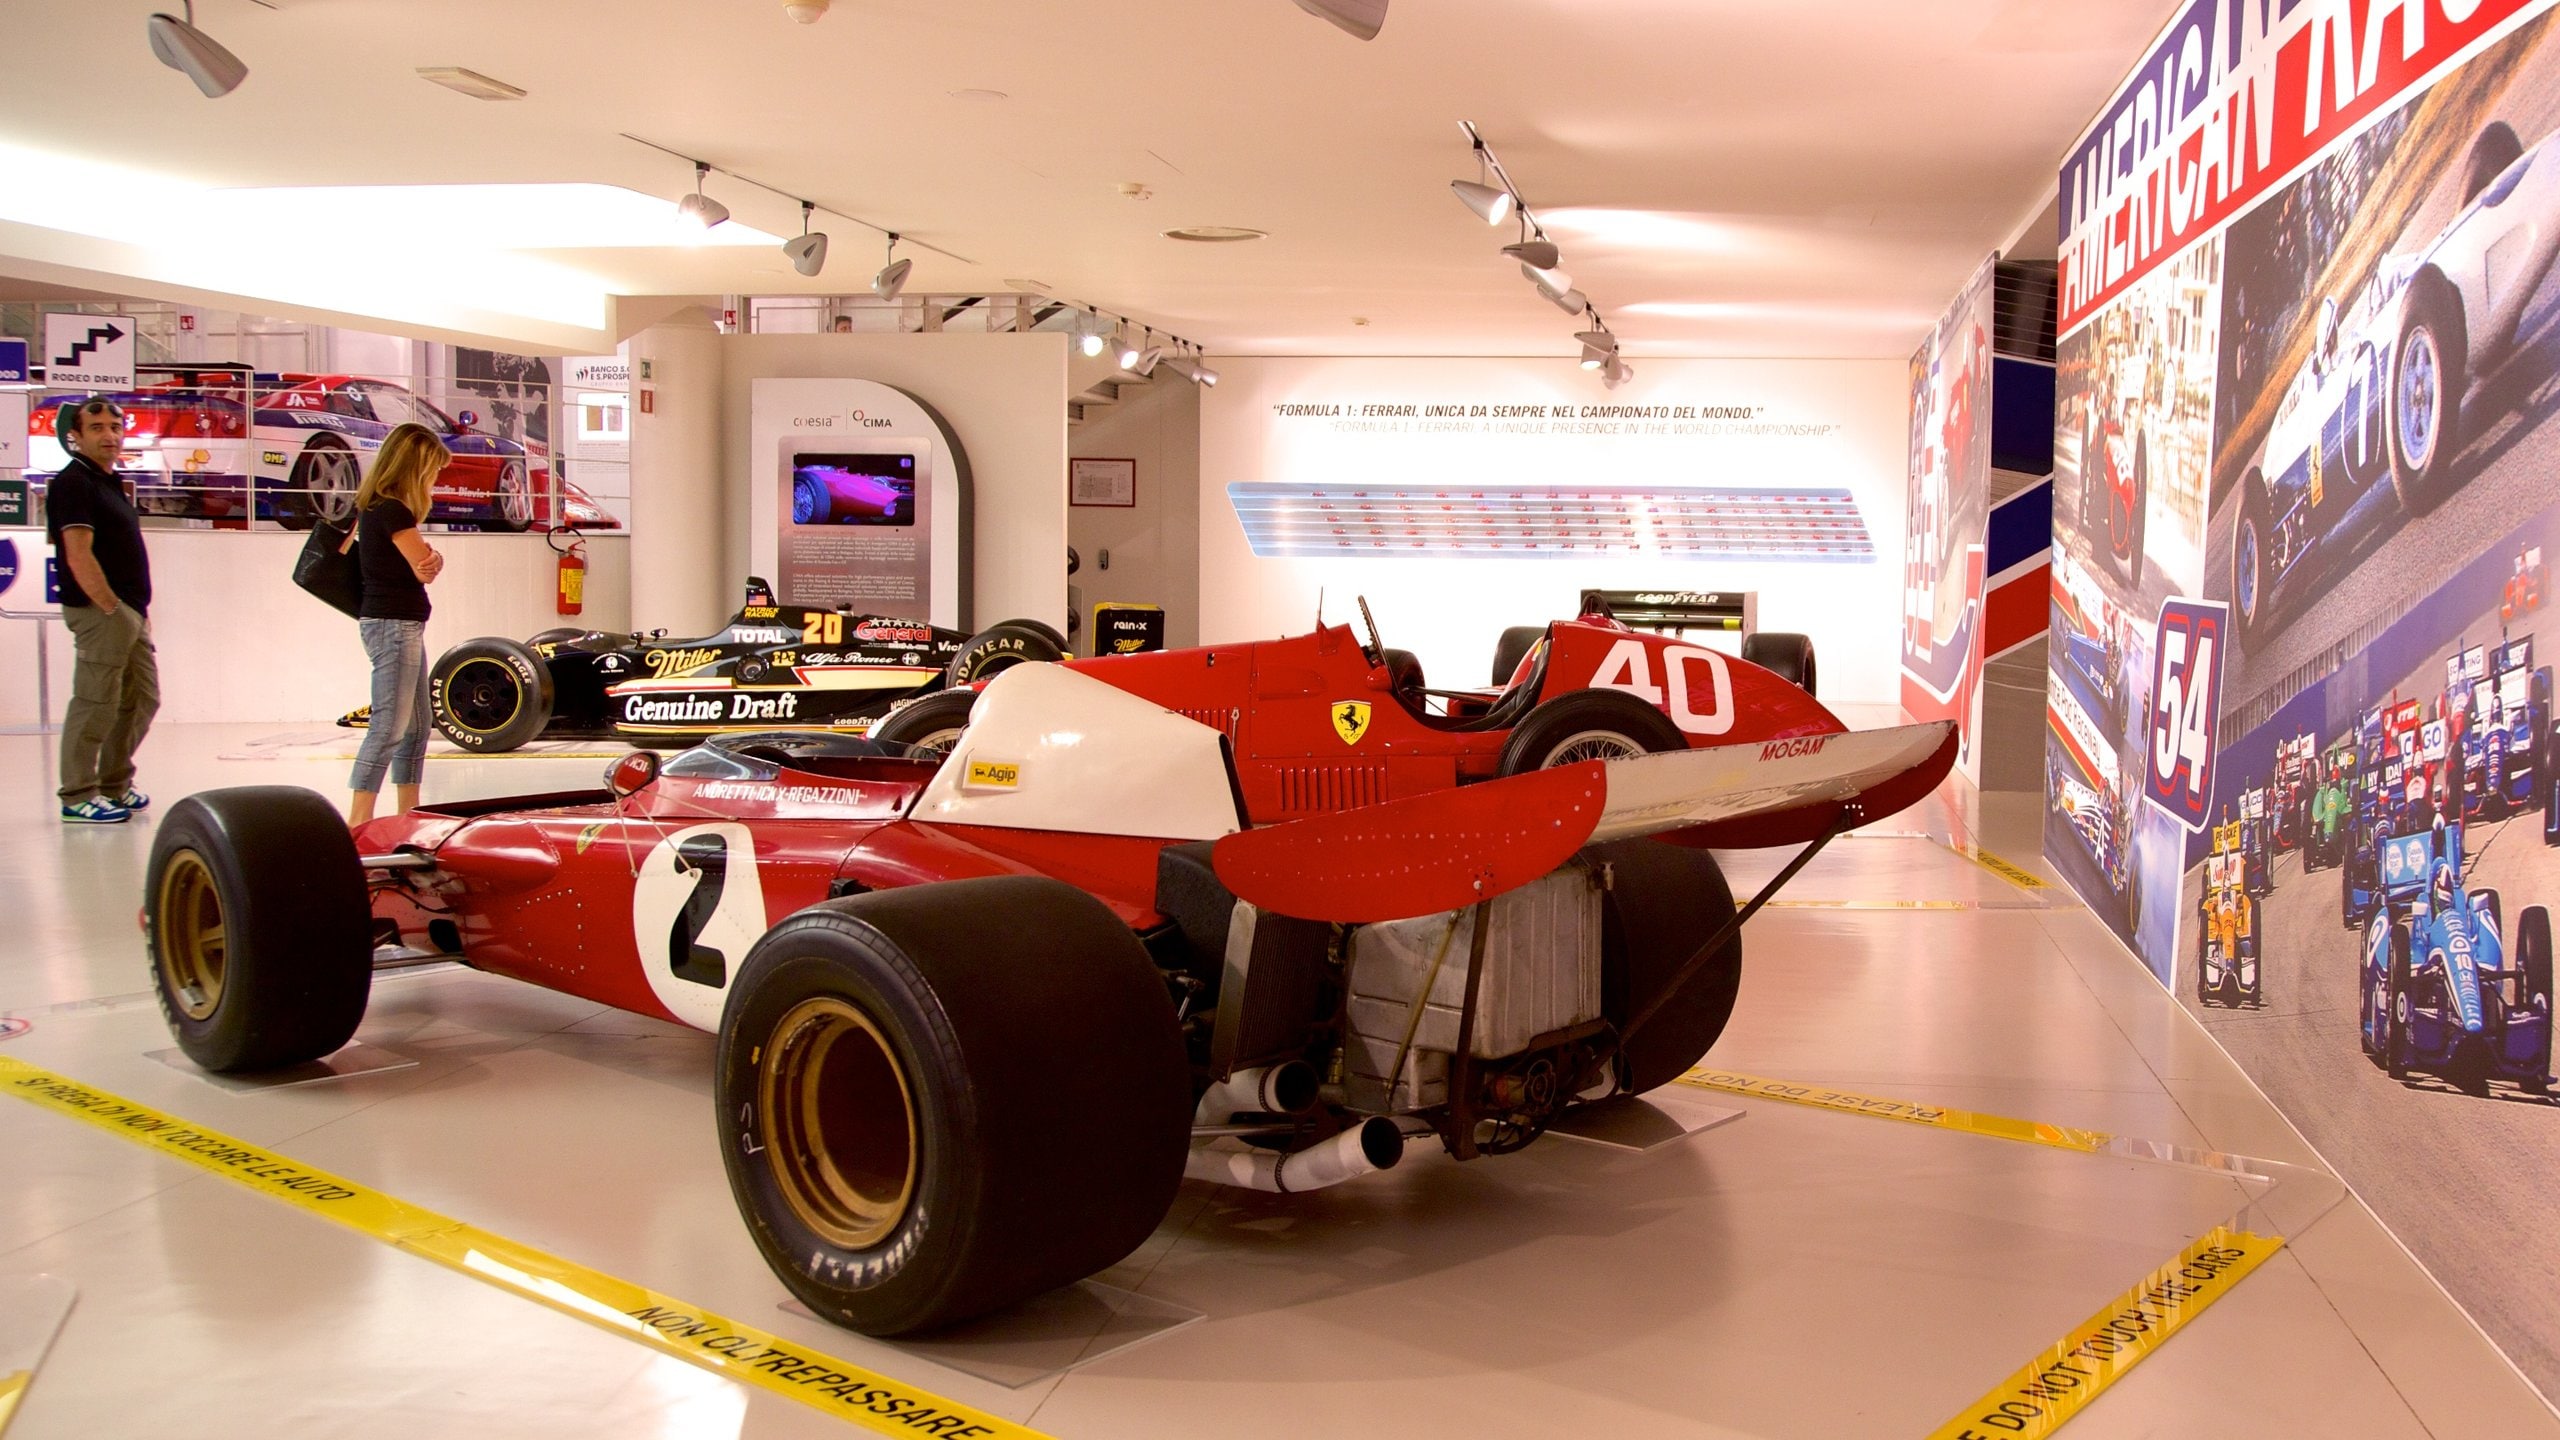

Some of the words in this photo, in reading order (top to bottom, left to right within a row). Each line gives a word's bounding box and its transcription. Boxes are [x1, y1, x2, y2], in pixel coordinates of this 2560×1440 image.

[2063, 50, 2278, 321] AMERICAN
[52, 373, 90, 383] RODEO
[93, 374, 129, 385] DRIVE
[863, 418, 893, 428] CIMA
[1273, 404, 1340, 417] “FORMULA
[1346, 404, 1357, 417] 1:
[1362, 405, 1419, 419] FERRARI,
[1424, 405, 1466, 417] UNICA
[1469, 405, 1487, 417] DA
[1492, 405, 1547, 418] SEMPRE
[1551, 406, 1576, 418] NEL
[1581, 406, 1668, 418] CAMPIONATO
[1673, 406, 1696, 419] DEL
[1702, 407, 1764, 420] MONDO.”
[1482, 422, 1491, 433] A
[1495, 421, 1547, 434] UNIQUE
[1551, 422, 1620, 435] PRESENCE
[1624, 423, 1639, 434] IN
[1643, 423, 1669, 435] THE
[1673, 423, 1721, 435] WORLD
[263, 453, 286, 464] OMP
[731, 628, 787, 644] TOTAL
[802, 612, 843, 644] 20
[856, 620, 932, 642] General
[1114, 638, 1146, 652] Miller
[506, 655, 532, 685] EAGLE
[645, 648, 722, 679] Miller
[803, 652, 844, 666] Alfa
[844, 651, 897, 664] Romeo
[1588, 638, 1736, 735] 40
[625, 693, 723, 721] Genuine
[729, 692, 798, 719] Draft
[2155, 625, 2215, 798] 54
[1759, 738, 1825, 762] MOGAM
[987, 766, 1016, 782] Agip
[669, 833, 727, 989] 2
[1688, 1071, 1758, 1088] NOT
[1763, 1083, 1812, 1097] DO
[1813, 1090, 1945, 1121] PLEASE
[45, 1084, 102, 1108] PREGA
[90, 1101, 121, 1118] DI
[118, 1111, 163, 1134] NON
[156, 1128, 255, 1168] TOCCARE
[244, 1156, 279, 1178] LE
[272, 1172, 357, 1201] AUTO
[1980, 1401, 2044, 1431] DO
[2019, 1361, 2092, 1403] NOT
[2067, 1309, 2164, 1361] TOUCH
[2137, 1279, 2202, 1317] THE
[2178, 1246, 2246, 1282] CARS
[627, 1305, 719, 1338] NON
[701, 1336, 995, 1440] OLTREPASSARE
